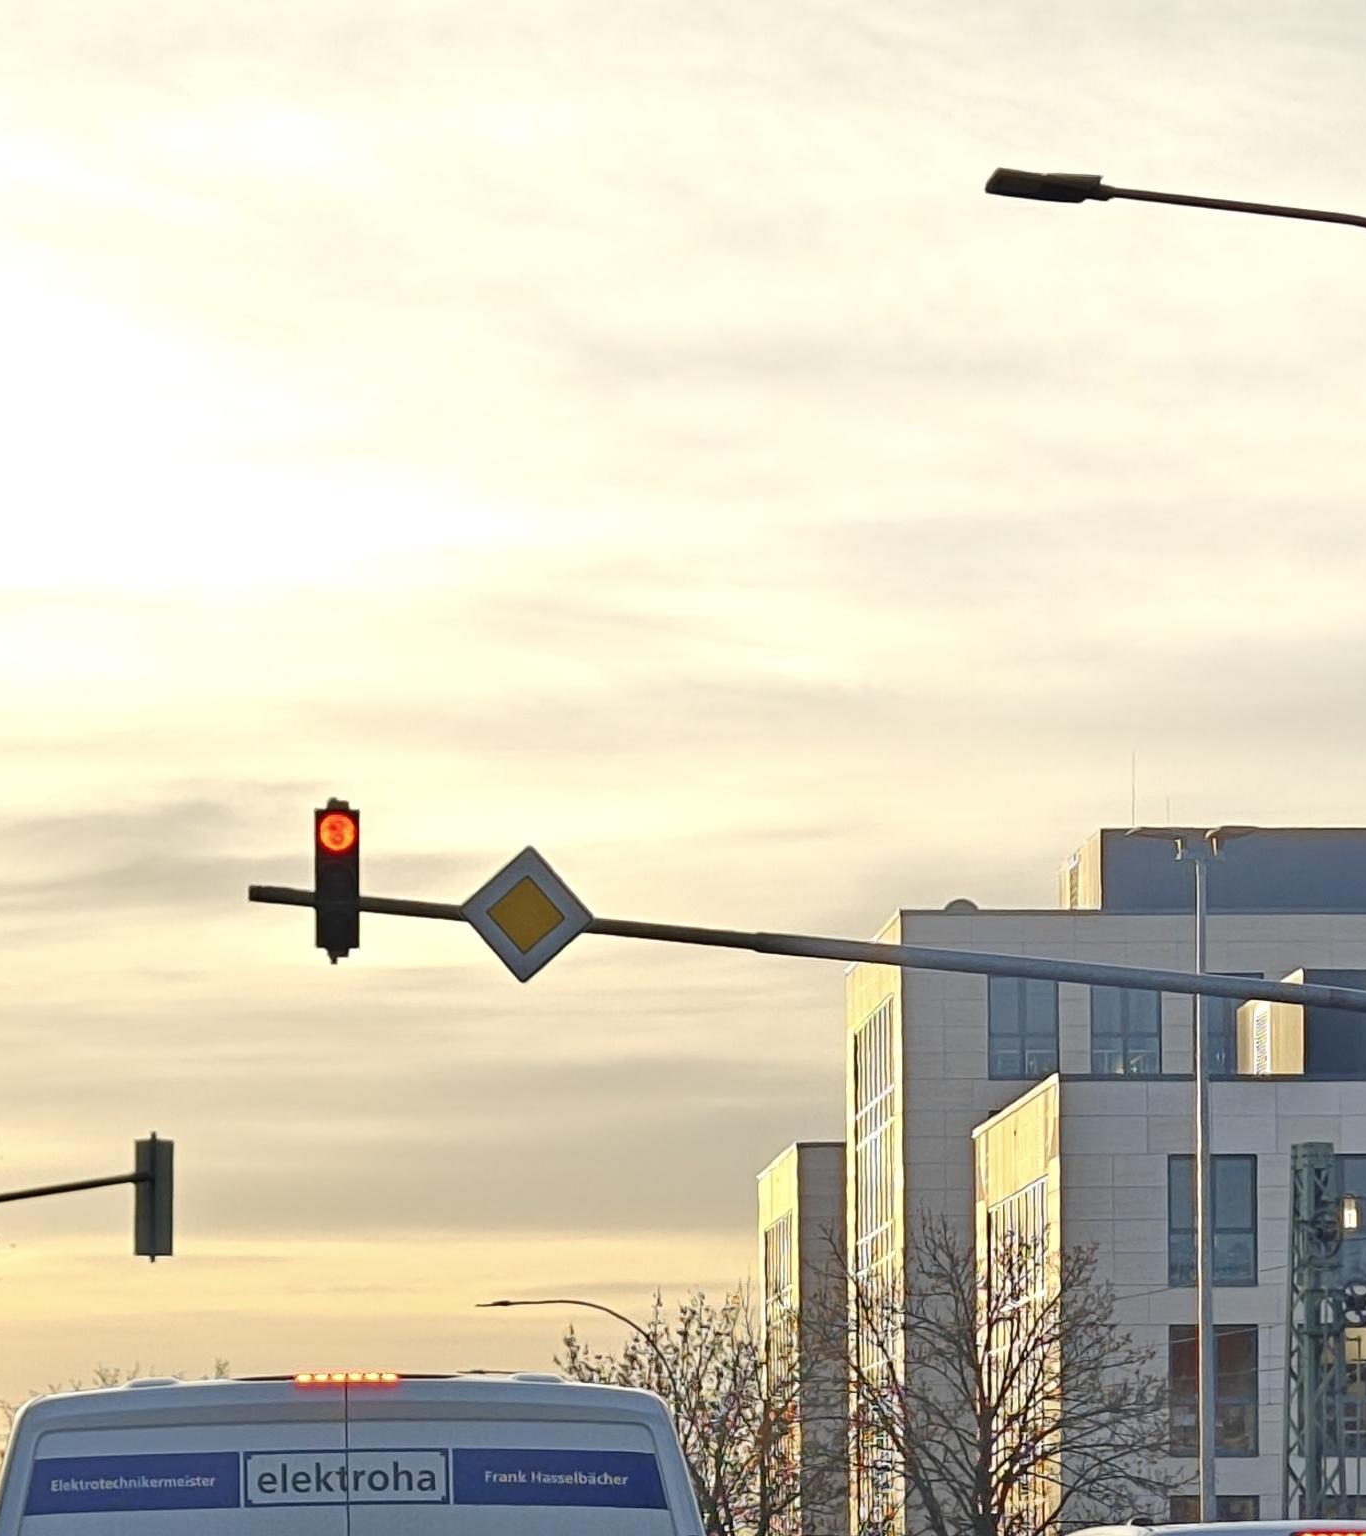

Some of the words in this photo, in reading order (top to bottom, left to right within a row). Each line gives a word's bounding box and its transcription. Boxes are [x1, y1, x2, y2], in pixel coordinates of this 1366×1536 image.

[50, 1475, 216, 1492] Elektrotechnikermeister
[256, 1461, 437, 1494] elektroha
[484, 1469, 527, 1484] Frank
[531, 1470, 629, 1487] Hasselbächer
